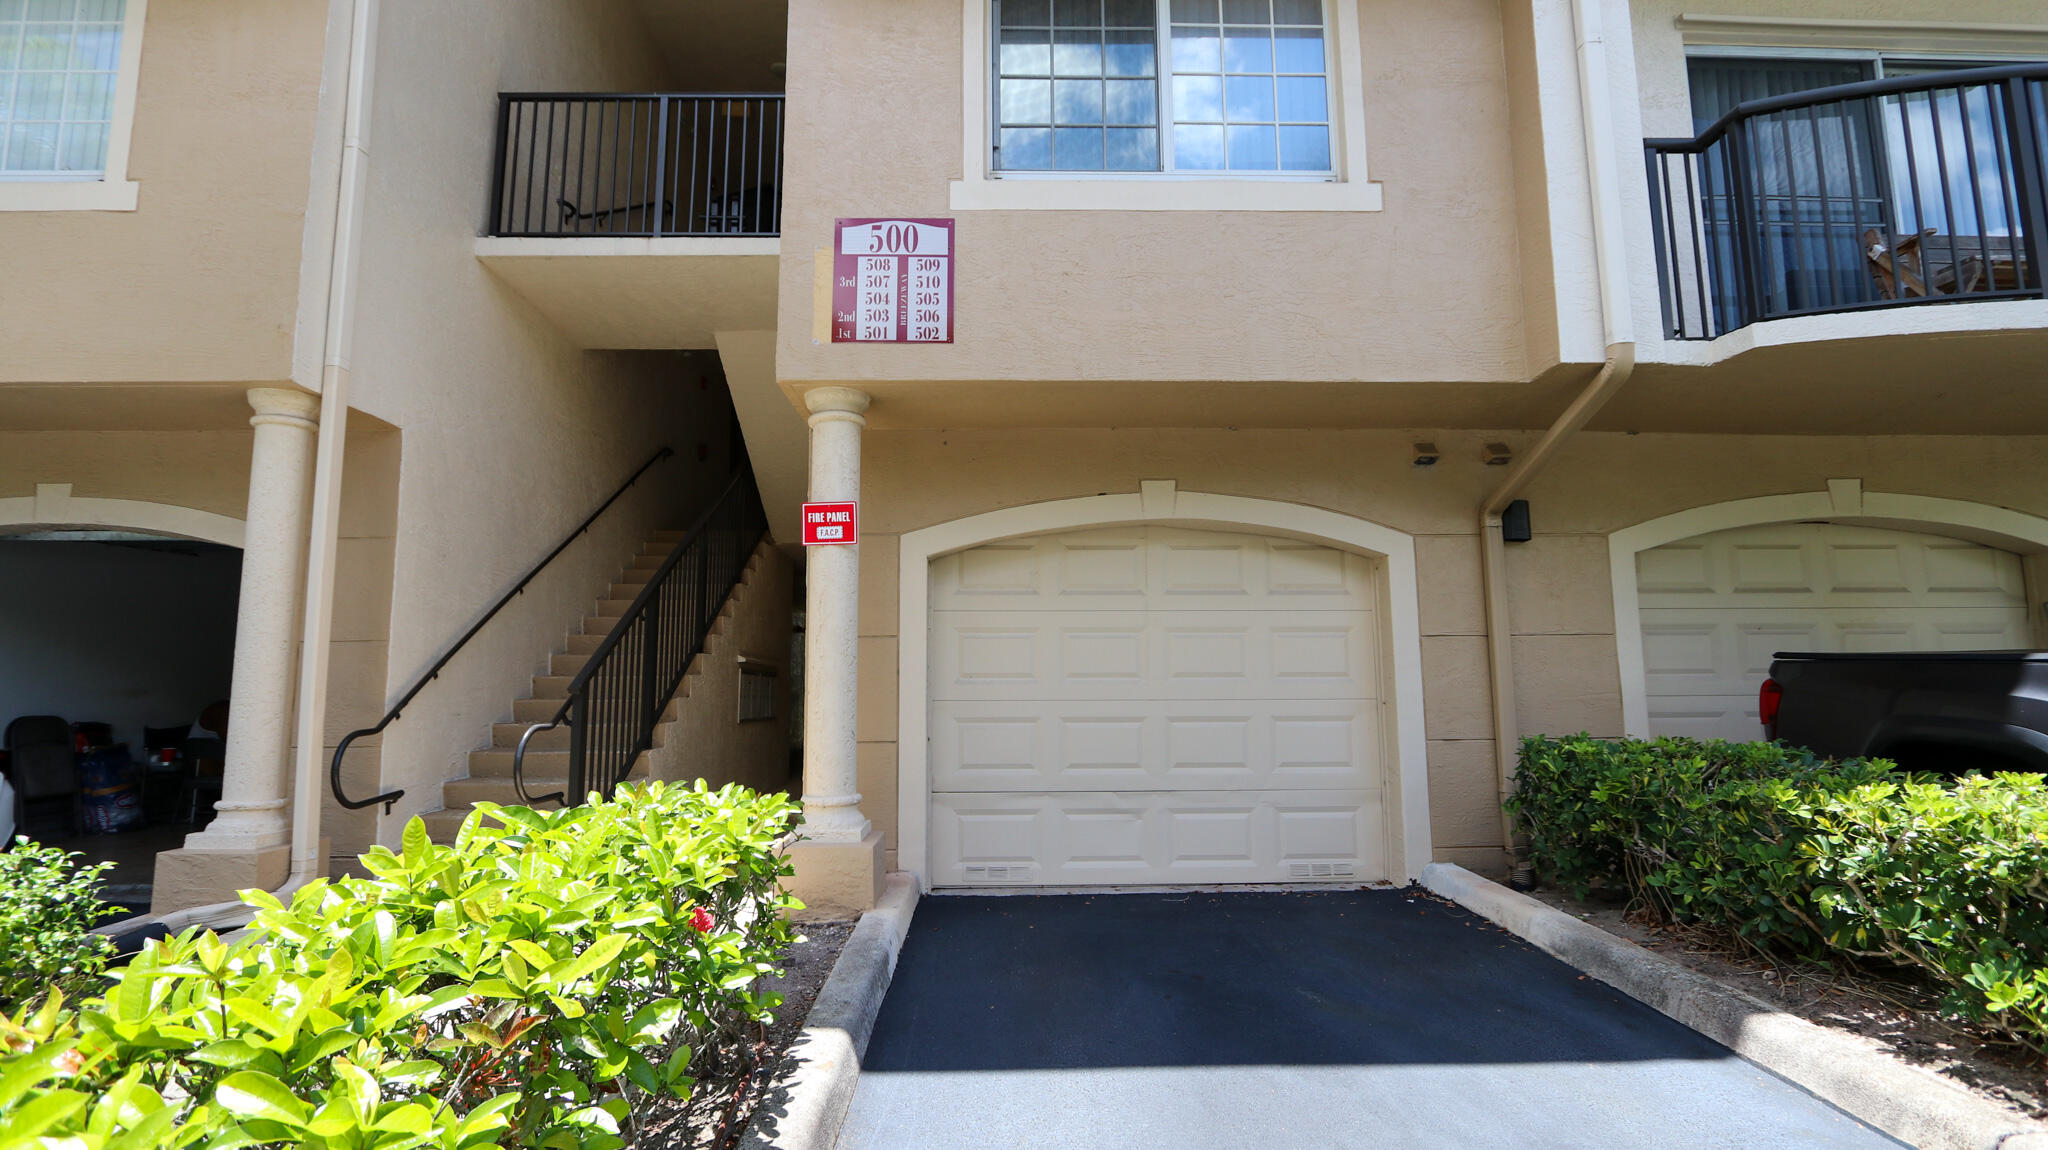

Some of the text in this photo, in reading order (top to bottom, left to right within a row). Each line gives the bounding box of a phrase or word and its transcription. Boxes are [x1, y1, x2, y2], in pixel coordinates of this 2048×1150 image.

[869, 224, 919, 253] 500
[866, 258, 891, 271] 508
[916, 259, 940, 271] 509
[839, 276, 856, 287] 3rd
[865, 275, 890, 288] 507
[916, 275, 940, 288] 510
[865, 292, 890, 305] 504
[915, 292, 940, 305] 505
[837, 311, 856, 322] 2nd
[864, 309, 889, 322] 503
[915, 309, 940, 323] 506
[837, 328, 852, 338] 1st
[864, 326, 888, 339] 501
[915, 326, 940, 340] 502
[807, 511, 851, 523] FIRE PANEL
